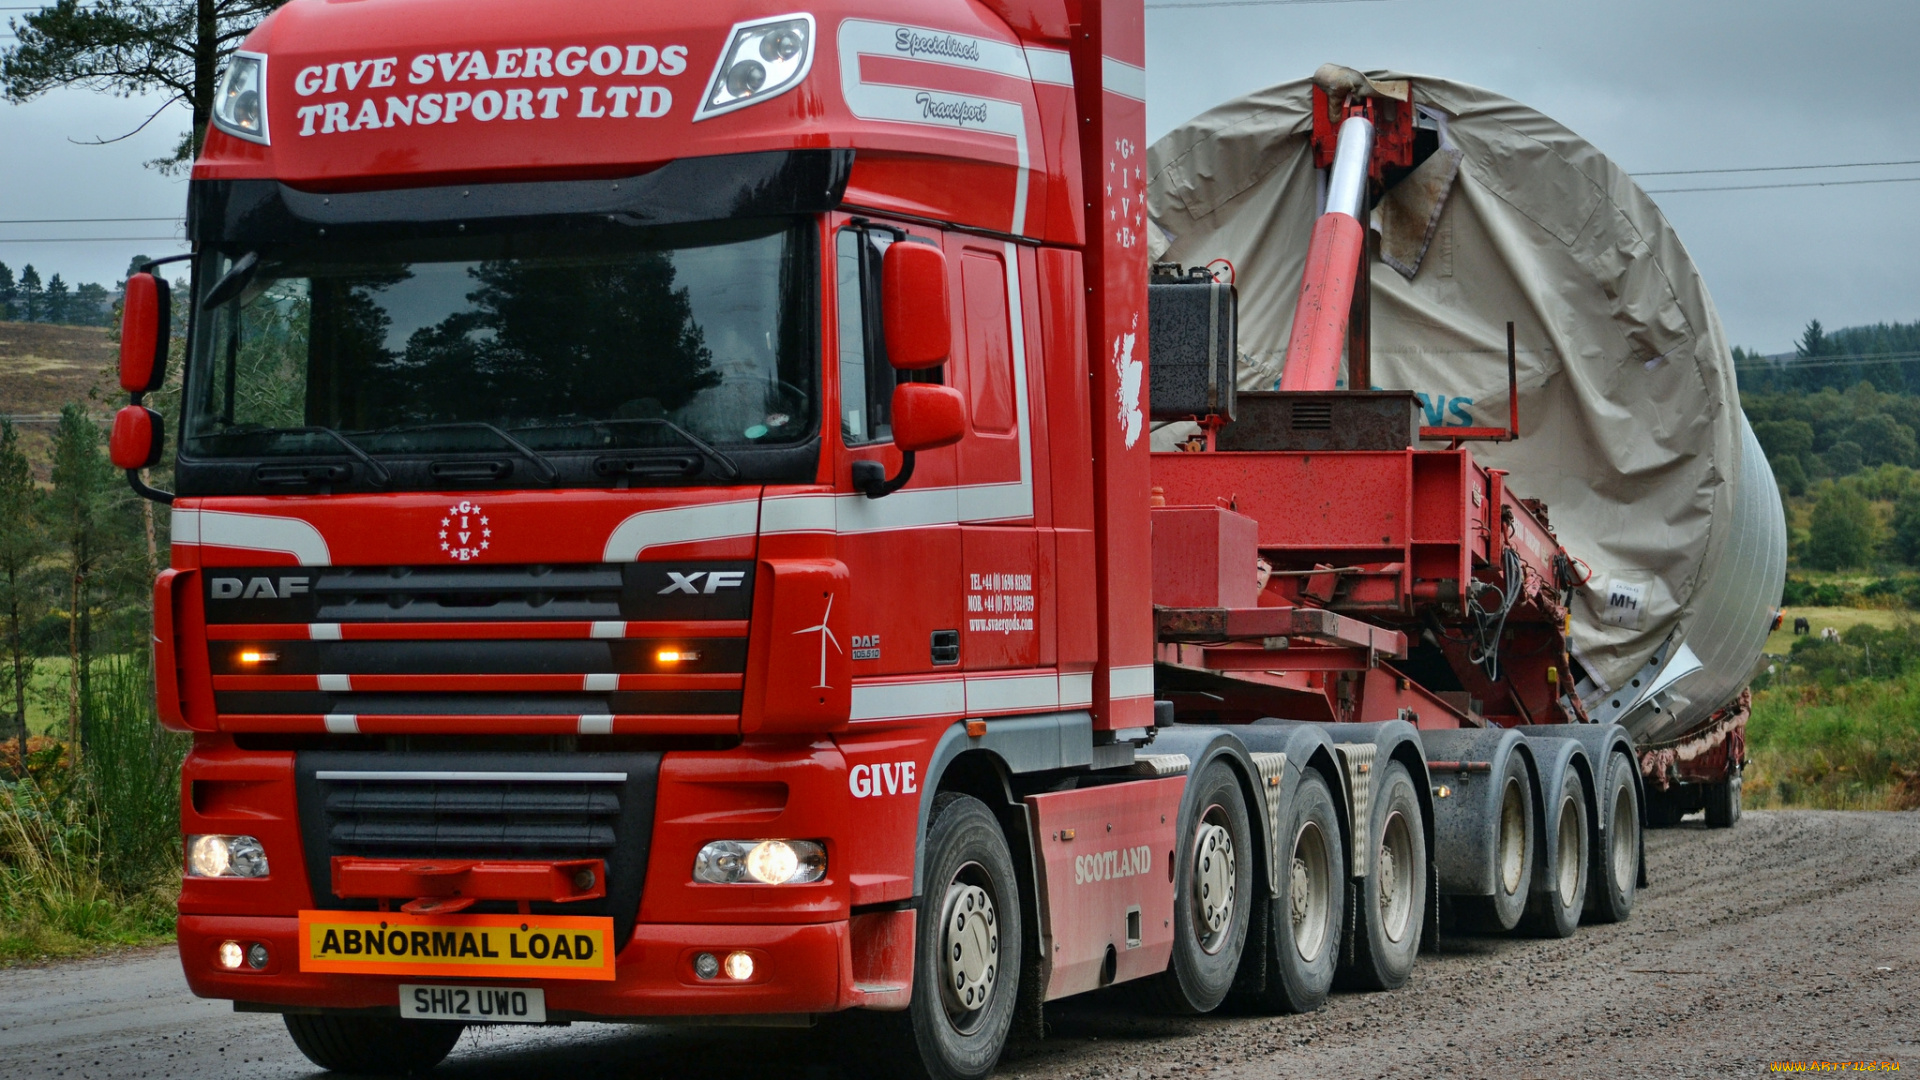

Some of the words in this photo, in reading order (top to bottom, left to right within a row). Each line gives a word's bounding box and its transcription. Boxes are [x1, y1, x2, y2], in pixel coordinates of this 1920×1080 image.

[895, 28, 980, 62] Specialised
[295, 57, 398, 96] GIVE
[408, 45, 688, 84] SVAERGODS
[297, 87, 569, 136] TRANSPORT
[576, 86, 673, 118] LTD
[915, 92, 987, 126] Transport
[1120, 138, 1130, 248] GIVE
[458, 500, 471, 561] GIVE
[211, 576, 310, 599] DAF
[656, 571, 746, 594] XF
[1610, 592, 1637, 610] MH
[851, 634, 880, 648] DAF
[969, 613, 1034, 635] www.svaergods.com
[849, 761, 917, 798] GIVE
[1075, 845, 1151, 885] SCOTLAND
[321, 928, 499, 958] ABNORMAL
[509, 933, 594, 960] LOAD
[415, 988, 470, 1013] SH12
[478, 990, 528, 1016] UWO
